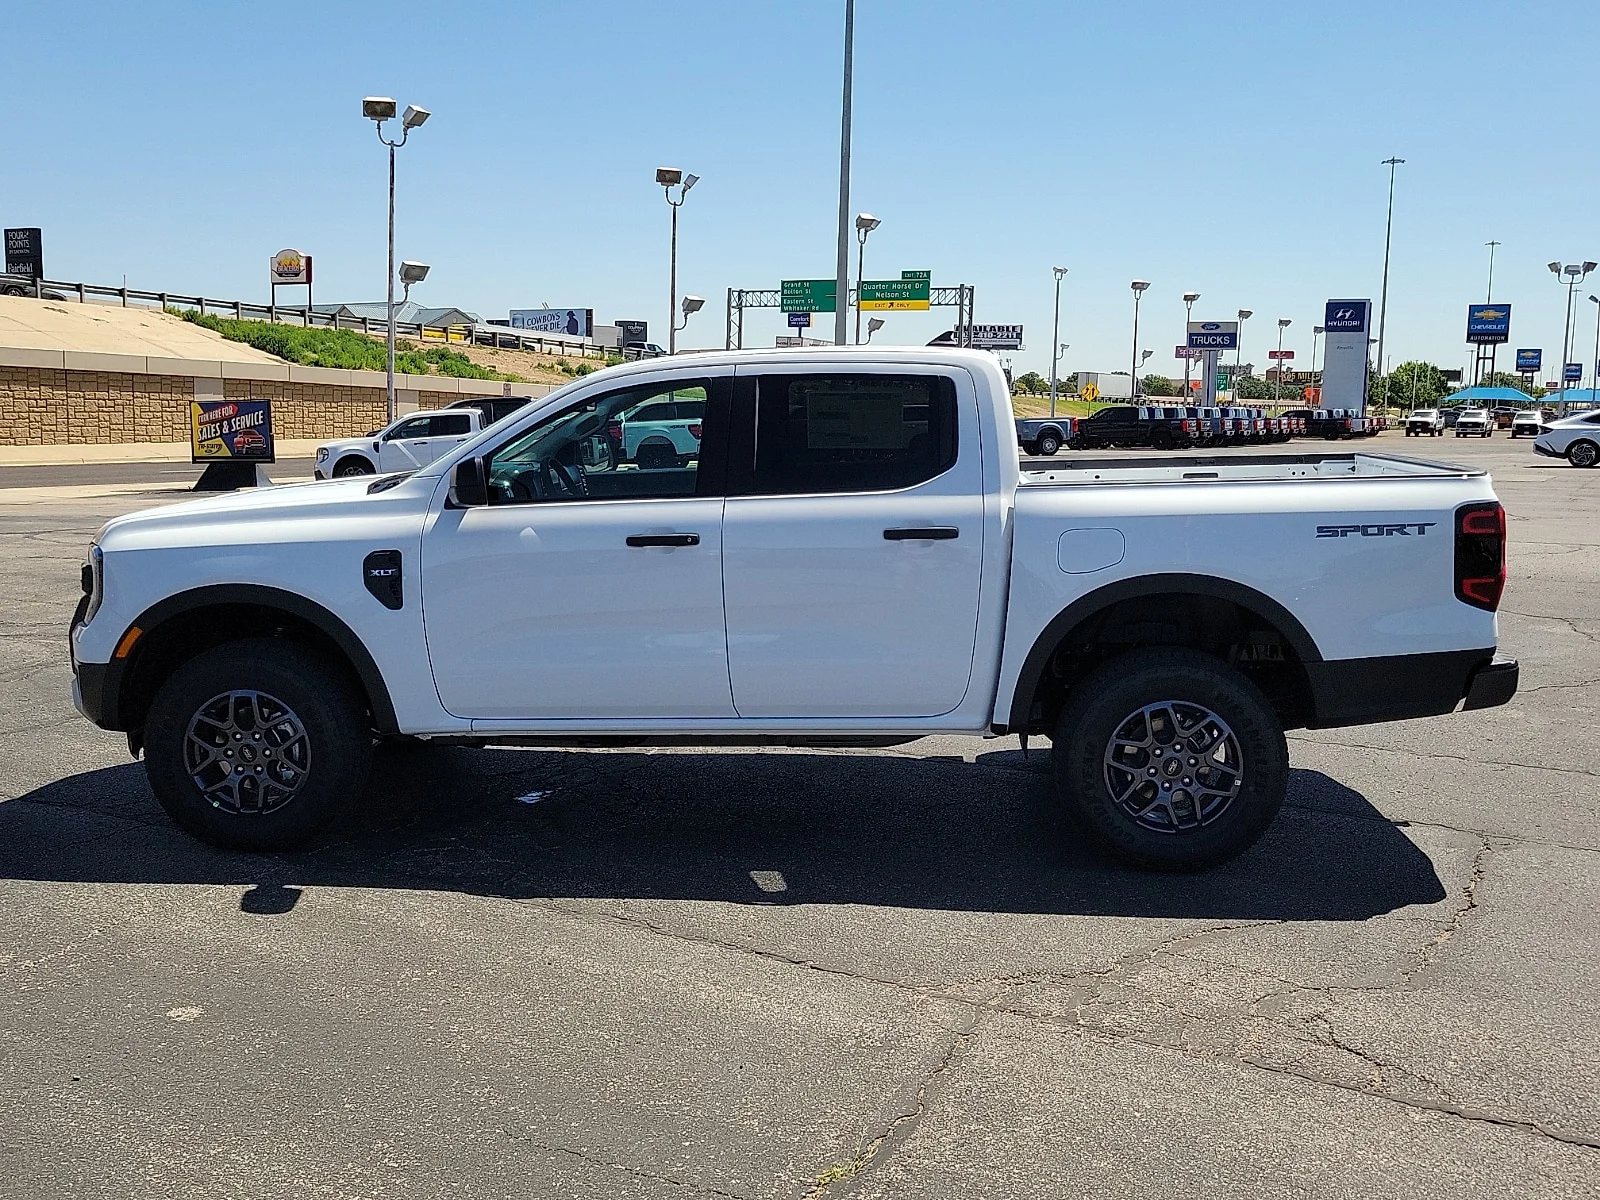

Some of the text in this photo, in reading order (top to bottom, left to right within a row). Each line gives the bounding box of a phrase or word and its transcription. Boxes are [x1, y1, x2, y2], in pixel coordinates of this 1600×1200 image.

[8, 231, 24, 239] FOUR
[9, 240, 30, 248] POINTS
[8, 262, 33, 273] Fairfield
[526, 312, 560, 326] COWBOYS
[549, 321, 561, 330] DIE
[1191, 336, 1230, 345] TRUCKS
[222, 405, 234, 417] FOR
[197, 410, 264, 442] SALES & SERVICE
[1315, 522, 1438, 538] SPORT
[370, 568, 397, 577] XLT
